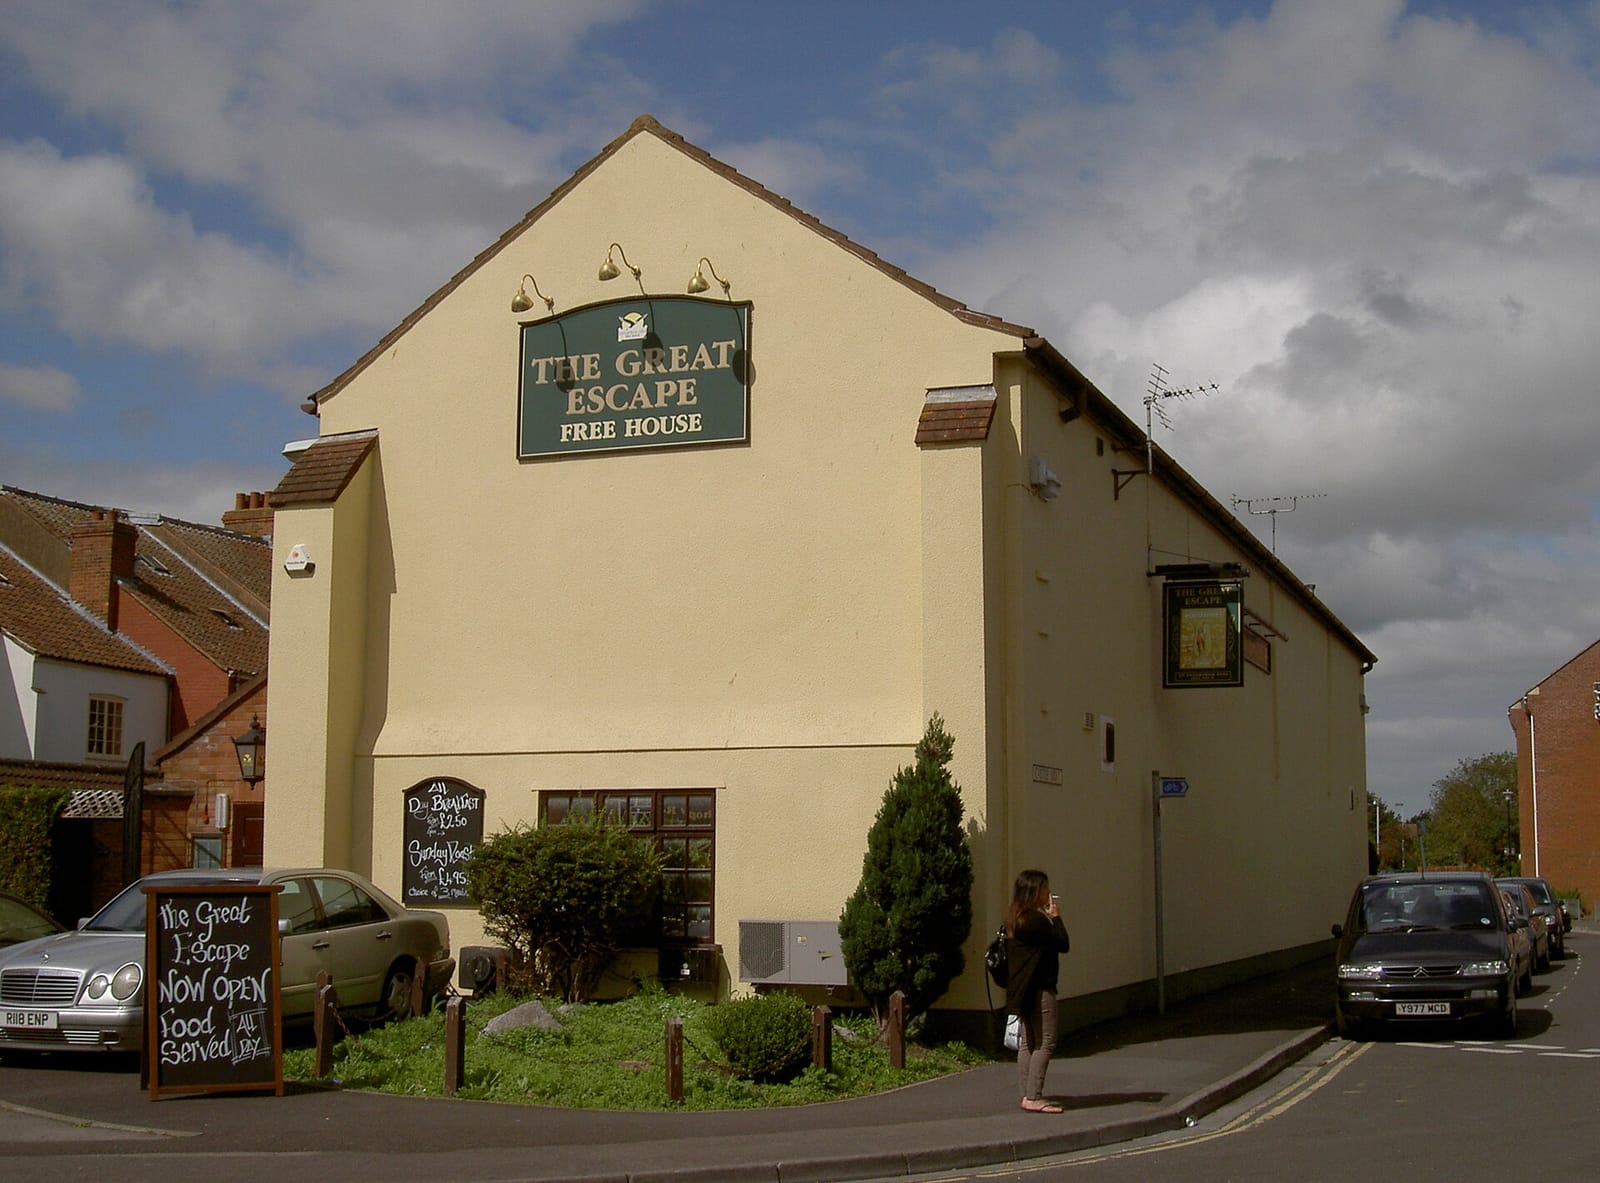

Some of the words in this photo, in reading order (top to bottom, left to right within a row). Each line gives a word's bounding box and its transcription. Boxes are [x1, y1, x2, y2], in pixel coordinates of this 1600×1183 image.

[532, 353, 601, 385] THE
[615, 339, 736, 377] GREAT
[566, 378, 697, 415] ESCAPE
[560, 420, 616, 442] FREE
[624, 413, 702, 438] HOUSE
[408, 840, 449, 867] Sunday
[195, 896, 253, 942] Great
[172, 932, 250, 973] Escape
[158, 968, 211, 1004] NOW
[213, 968, 271, 1009] OPEN
[6, 1012, 25, 1025] R118
[27, 1013, 49, 1025] ENP
[160, 1006, 216, 1038] Food
[1401, 1004, 1424, 1013] Y977
[161, 1029, 232, 1065] Served
